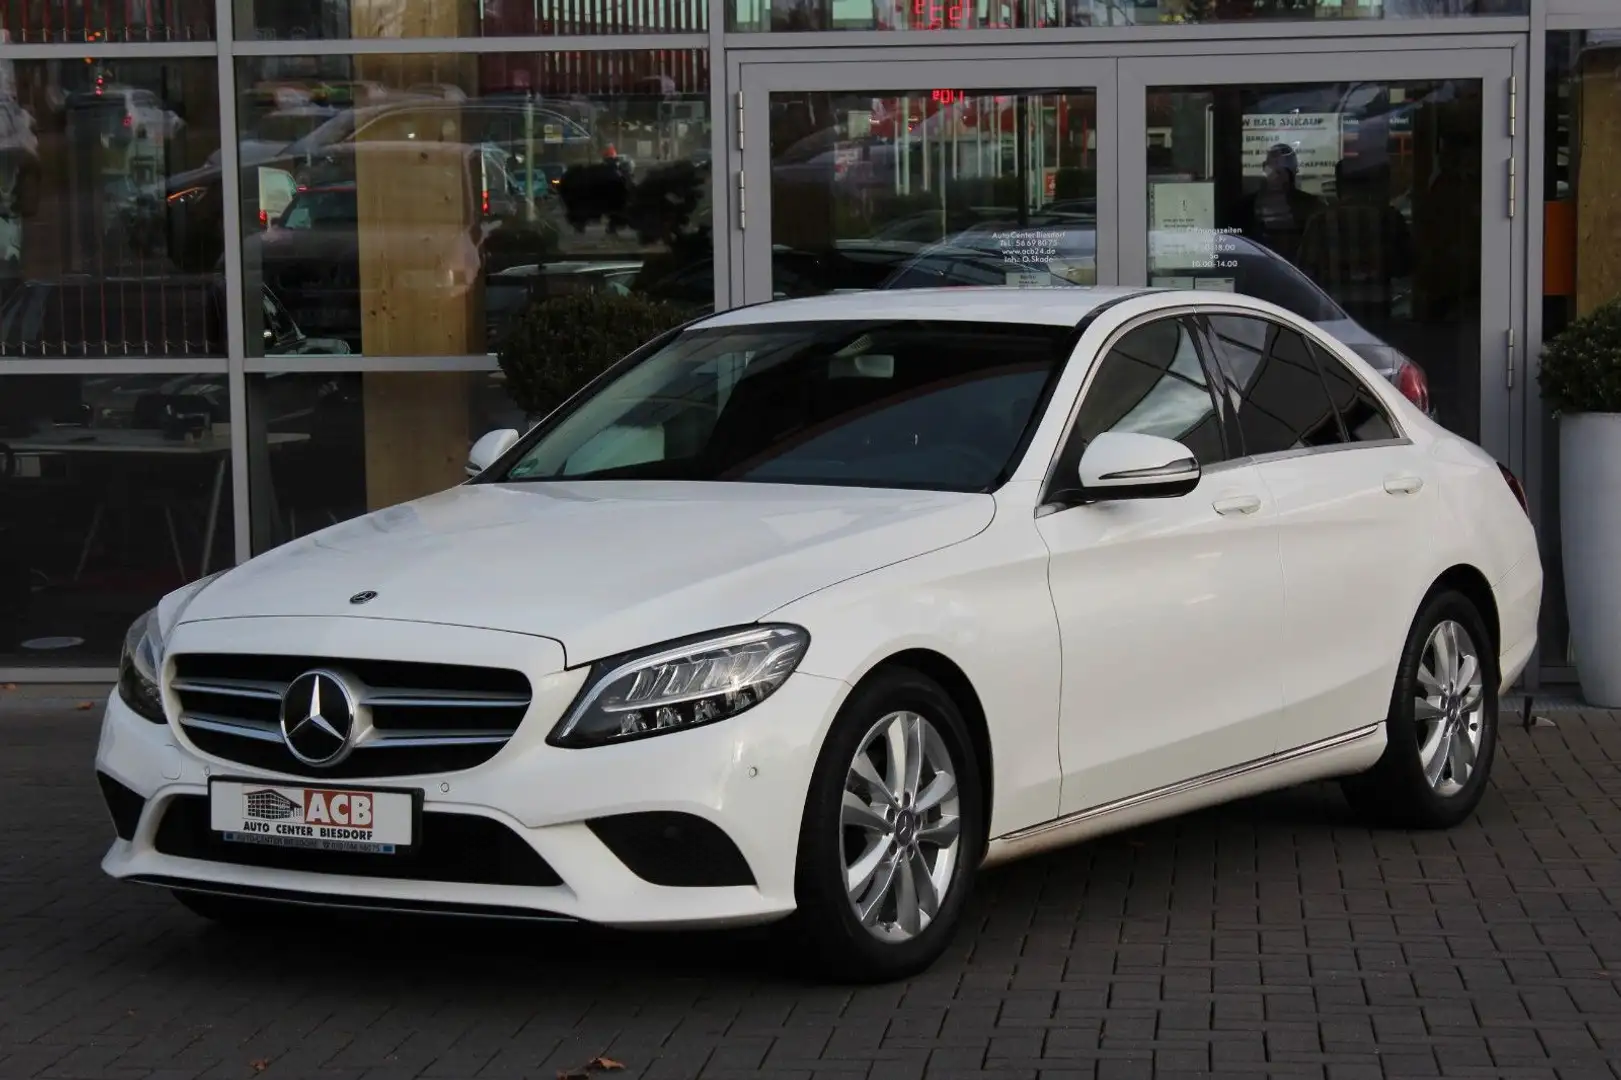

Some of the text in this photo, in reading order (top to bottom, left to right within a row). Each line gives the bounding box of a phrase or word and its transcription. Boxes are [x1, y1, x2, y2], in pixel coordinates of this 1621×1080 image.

[306, 793, 372, 825] ACB
[243, 821, 373, 841] AUTO CENTER BIESDORF
